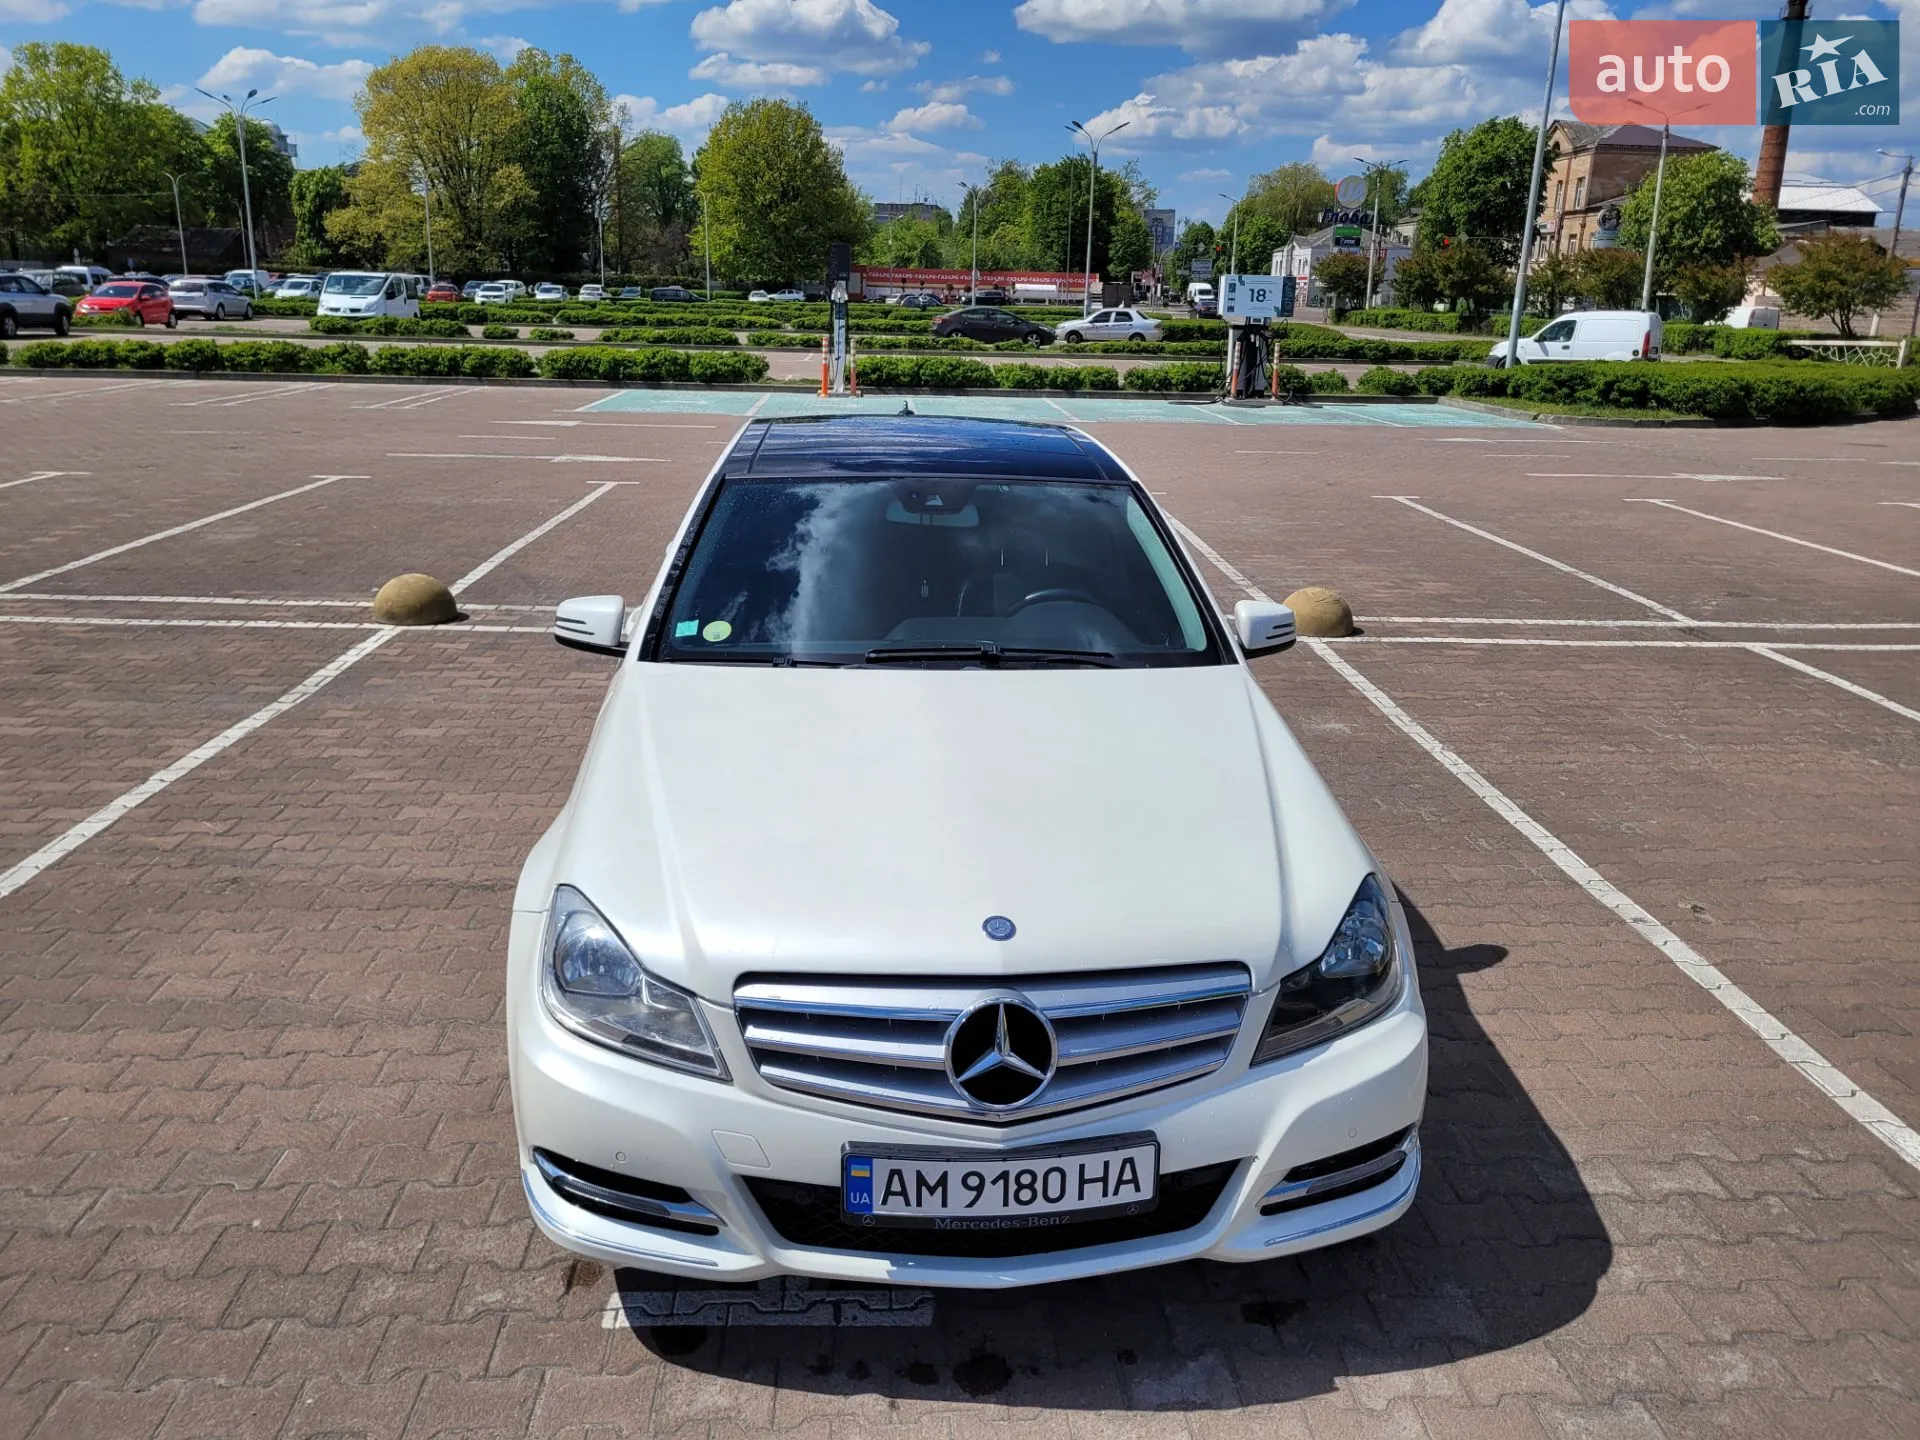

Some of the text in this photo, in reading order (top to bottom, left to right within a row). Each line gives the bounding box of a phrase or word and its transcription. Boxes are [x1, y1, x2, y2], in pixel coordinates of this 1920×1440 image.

[881, 1156, 1142, 1208] AM 9180 HA
[850, 1191, 871, 1205] UA
[935, 1214, 1070, 1230] Mercedes-Benz
